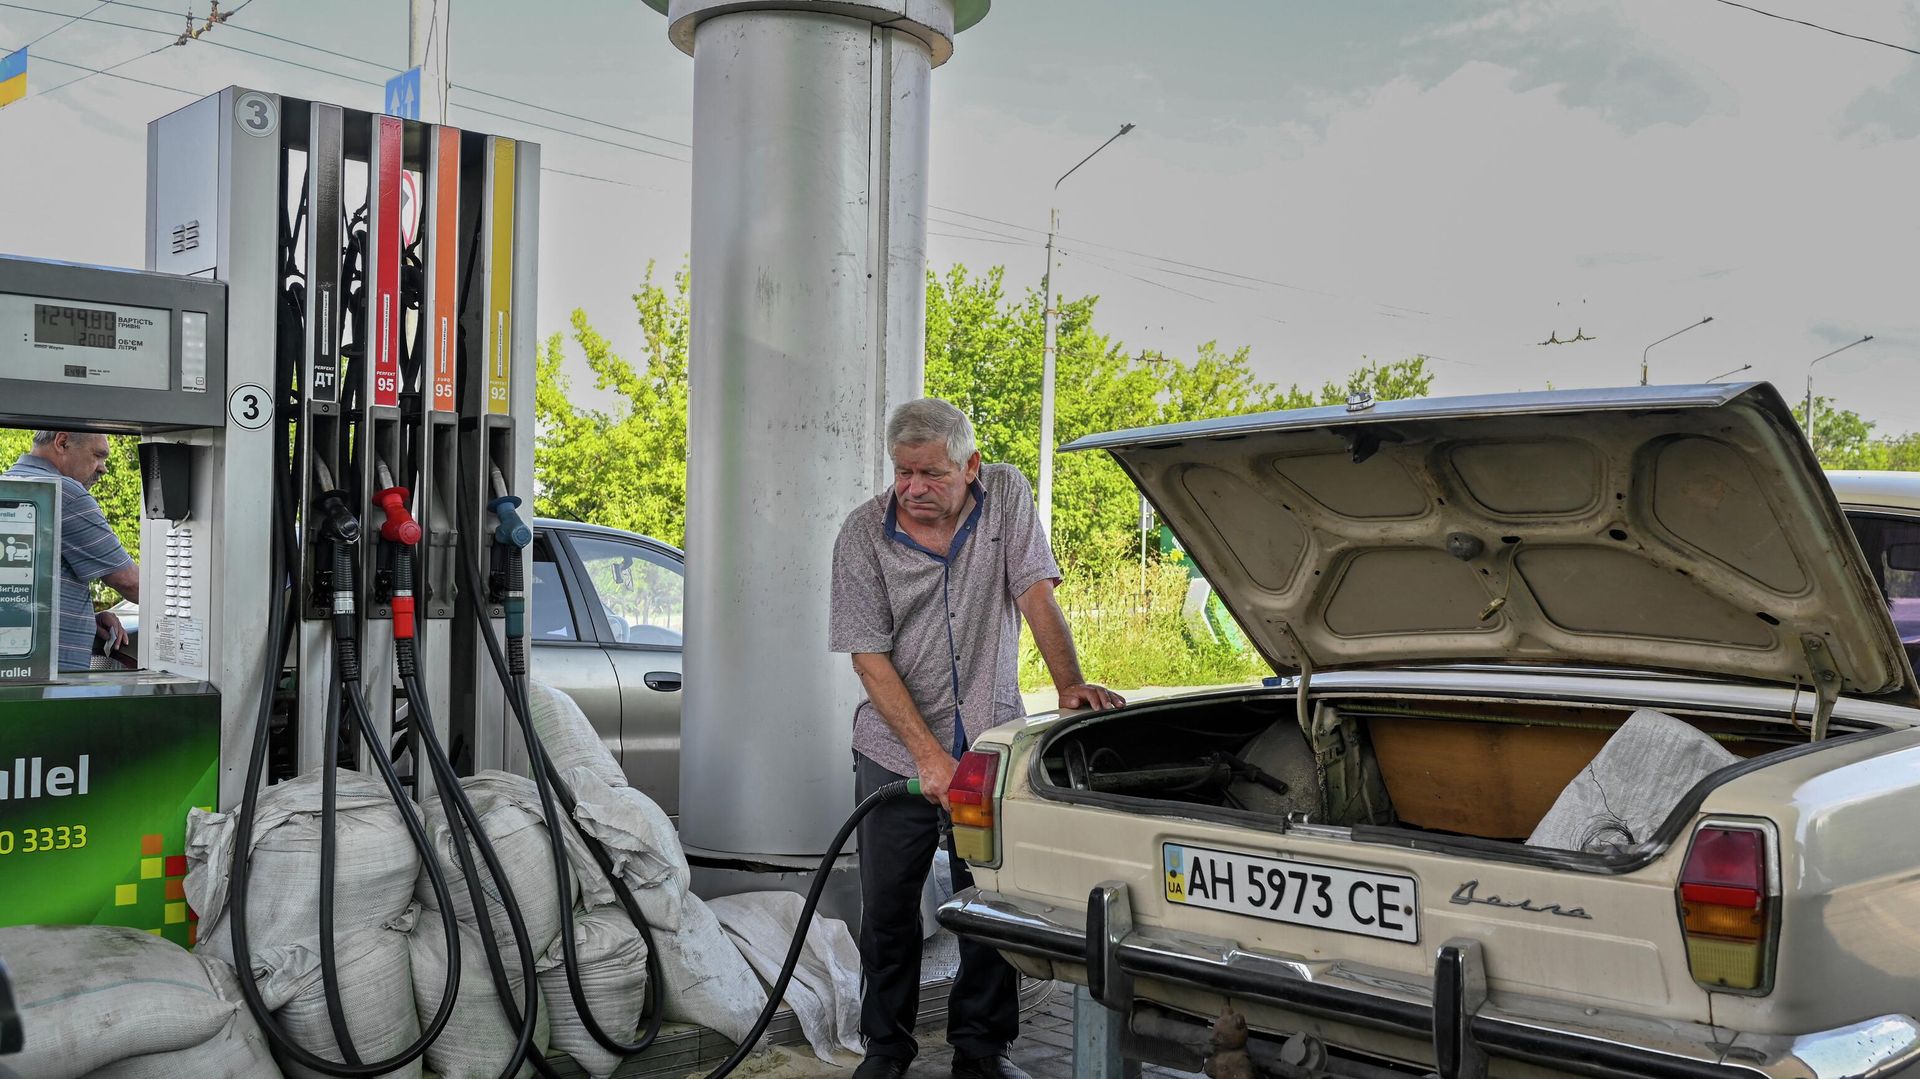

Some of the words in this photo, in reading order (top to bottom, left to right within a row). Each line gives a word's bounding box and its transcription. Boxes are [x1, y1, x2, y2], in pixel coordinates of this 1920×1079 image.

[246, 99, 269, 130] 3
[315, 372, 334, 388] ДТ
[377, 377, 395, 392] 95
[435, 383, 453, 398] 95
[491, 386, 506, 401] 92
[242, 394, 260, 420] 3
[22, 824, 87, 853] 3333
[1168, 881, 1183, 895] UA
[1188, 856, 1235, 903] AH
[1247, 864, 1333, 918] 5973
[1348, 881, 1403, 931] CE
